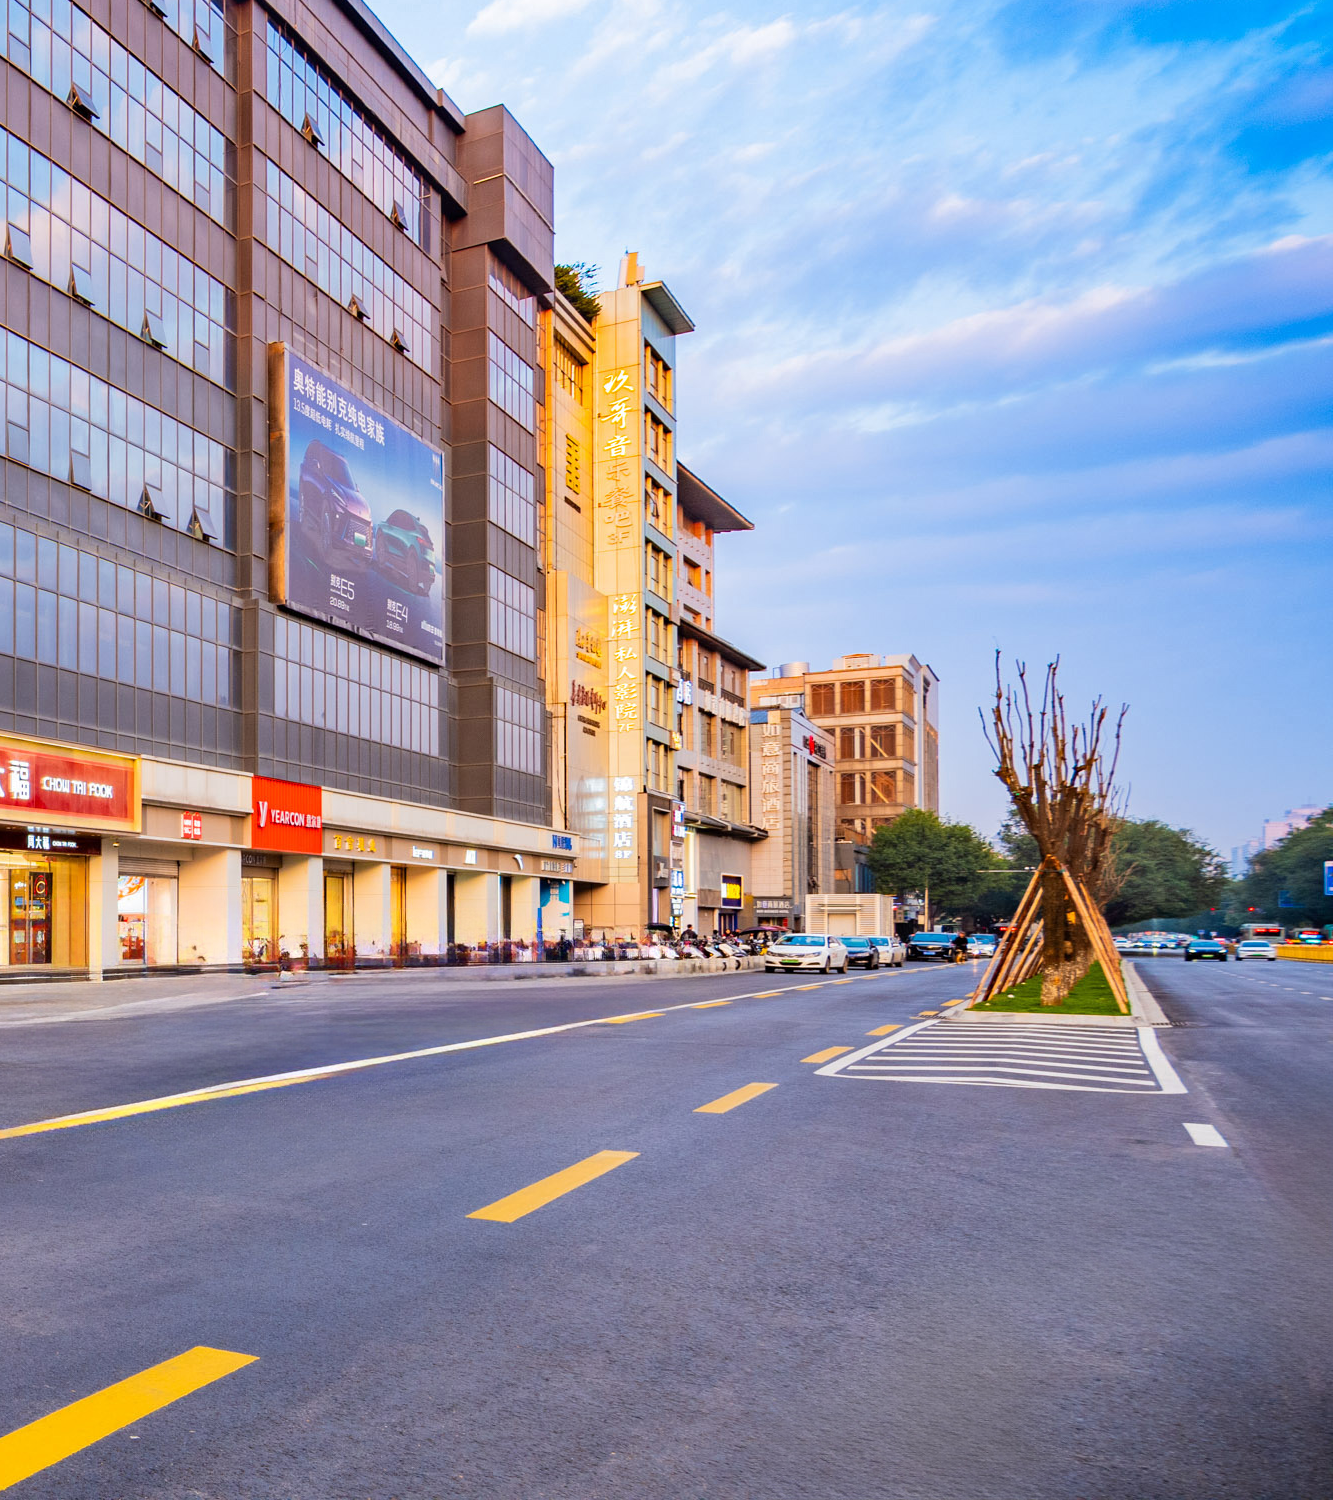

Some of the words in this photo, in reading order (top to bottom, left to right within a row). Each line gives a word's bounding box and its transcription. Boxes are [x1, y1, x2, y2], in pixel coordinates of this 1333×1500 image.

[293, 367, 385, 446] 奥特能别克纯电家族
[611, 593, 640, 720] 澎湃私人影院
[41, 776, 71, 794] CHOW
[71, 780, 87, 795] TAI
[88, 782, 113, 798] FOOK
[761, 722, 783, 831] 如意商旅酒店
[271, 809, 305, 827] YEARCON
